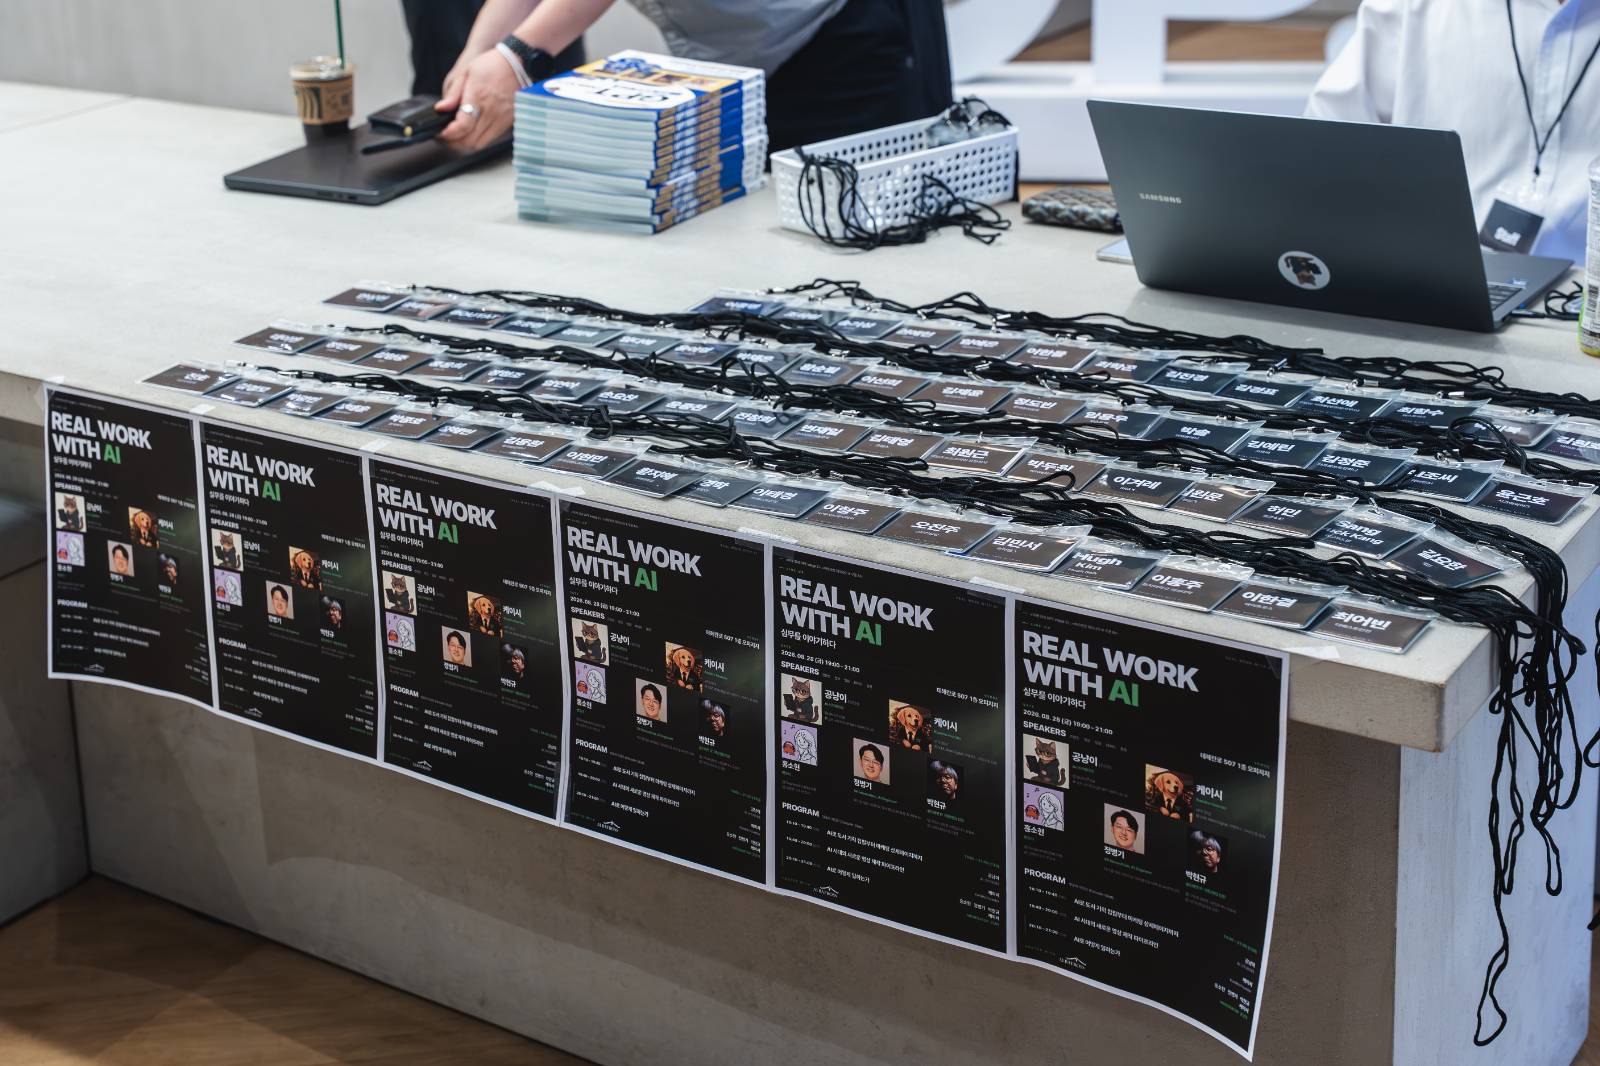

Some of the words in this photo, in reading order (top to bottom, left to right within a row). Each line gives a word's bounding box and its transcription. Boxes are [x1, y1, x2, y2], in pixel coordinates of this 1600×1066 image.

[1139, 193, 1182, 205] SAMSUNG
[51, 410, 96, 437] REAL
[97, 420, 152, 449] WORK
[52, 433, 101, 460] WITH
[104, 444, 120, 464] AI
[206, 444, 253, 473] REAL
[256, 455, 315, 487] WORK
[208, 467, 258, 496] WITH
[262, 480, 280, 501] AI
[376, 483, 428, 513] REAL
[430, 495, 497, 529] WORK
[378, 506, 434, 538] WITH
[438, 521, 458, 544] AI
[567, 525, 625, 558] REAL
[627, 539, 701, 576] WORK
[992, 536, 1043, 551] 김민서
[1072, 552, 1123, 566] Hugh
[1075, 562, 1103, 571] Kim
[568, 550, 630, 584] WITH
[634, 567, 657, 591] AI
[780, 574, 845, 610] REAL
[849, 590, 933, 630] WORK
[570, 606, 605, 619] SPEAKERS
[780, 601, 850, 638] WITH
[855, 620, 881, 646] AI
[802, 634, 836, 648] 이야기하다
[780, 660, 819, 675] SPEAKERS
[844, 664, 860, 672] 21:00
[1023, 630, 1098, 668] REAL
[1102, 647, 1198, 692] WORK
[1023, 658, 1102, 698] WITH
[1108, 679, 1138, 706] AI
[824, 689, 846, 703] 공냥이
[1047, 693, 1086, 709] 이야기하다
[934, 717, 957, 732] 케이시
[1023, 720, 1066, 736] SPEAKERS
[1095, 726, 1112, 735] 21:00
[575, 738, 607, 753] PROGRAM
[1072, 752, 1097, 766] 공냥이
[1196, 784, 1222, 800] 케이시
[782, 802, 819, 816] PROGRAM
[1024, 867, 1065, 884] PROGRAM
